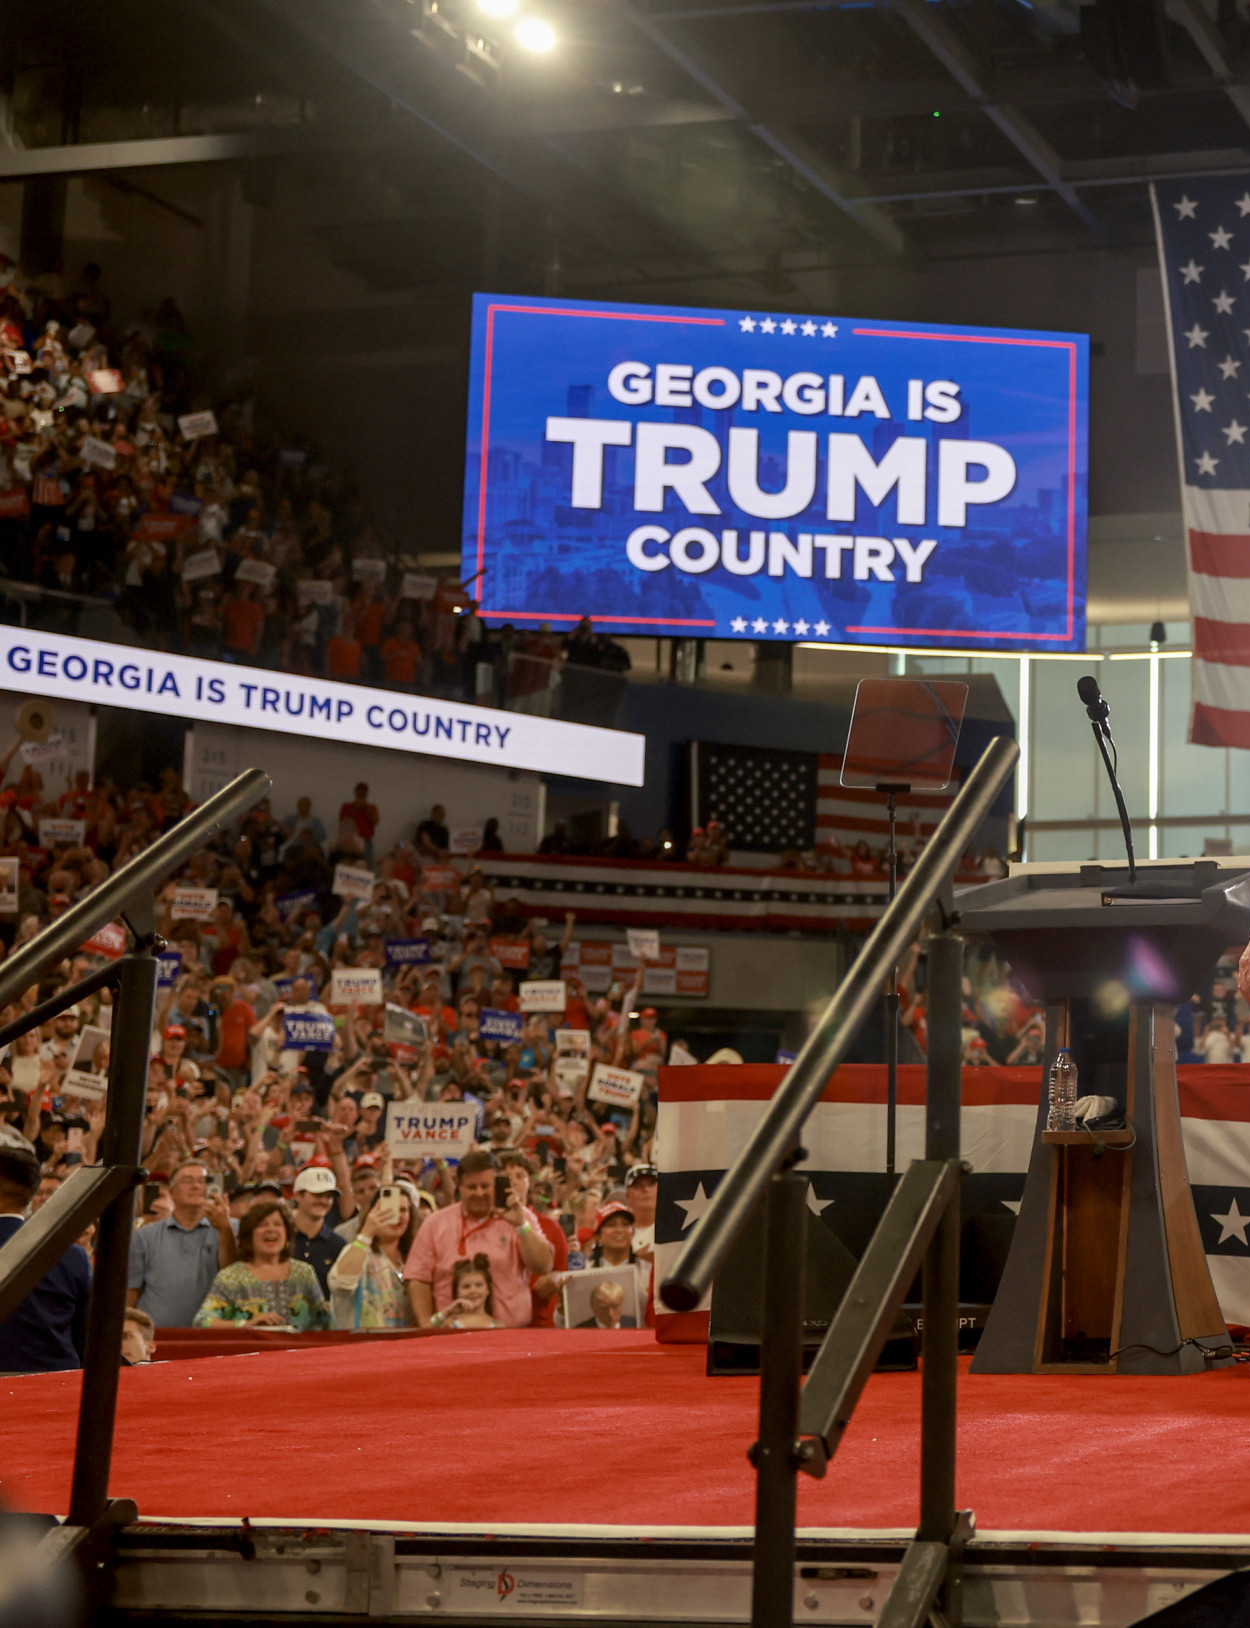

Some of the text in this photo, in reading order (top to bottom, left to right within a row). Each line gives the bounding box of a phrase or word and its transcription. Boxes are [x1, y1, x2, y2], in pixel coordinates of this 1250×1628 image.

[607, 360, 962, 424] GEORGIA IS
[545, 416, 1017, 528] TRUMP
[625, 525, 938, 583] COUNTRY
[7, 645, 512, 750] GEORGIA IS TRUMP COUNTRY
[393, 1116, 469, 1129] TRUMP
[401, 1129, 460, 1140] VANCE
[460, 1578, 496, 1589] Staging
[516, 1579, 573, 1590] Dimensions
